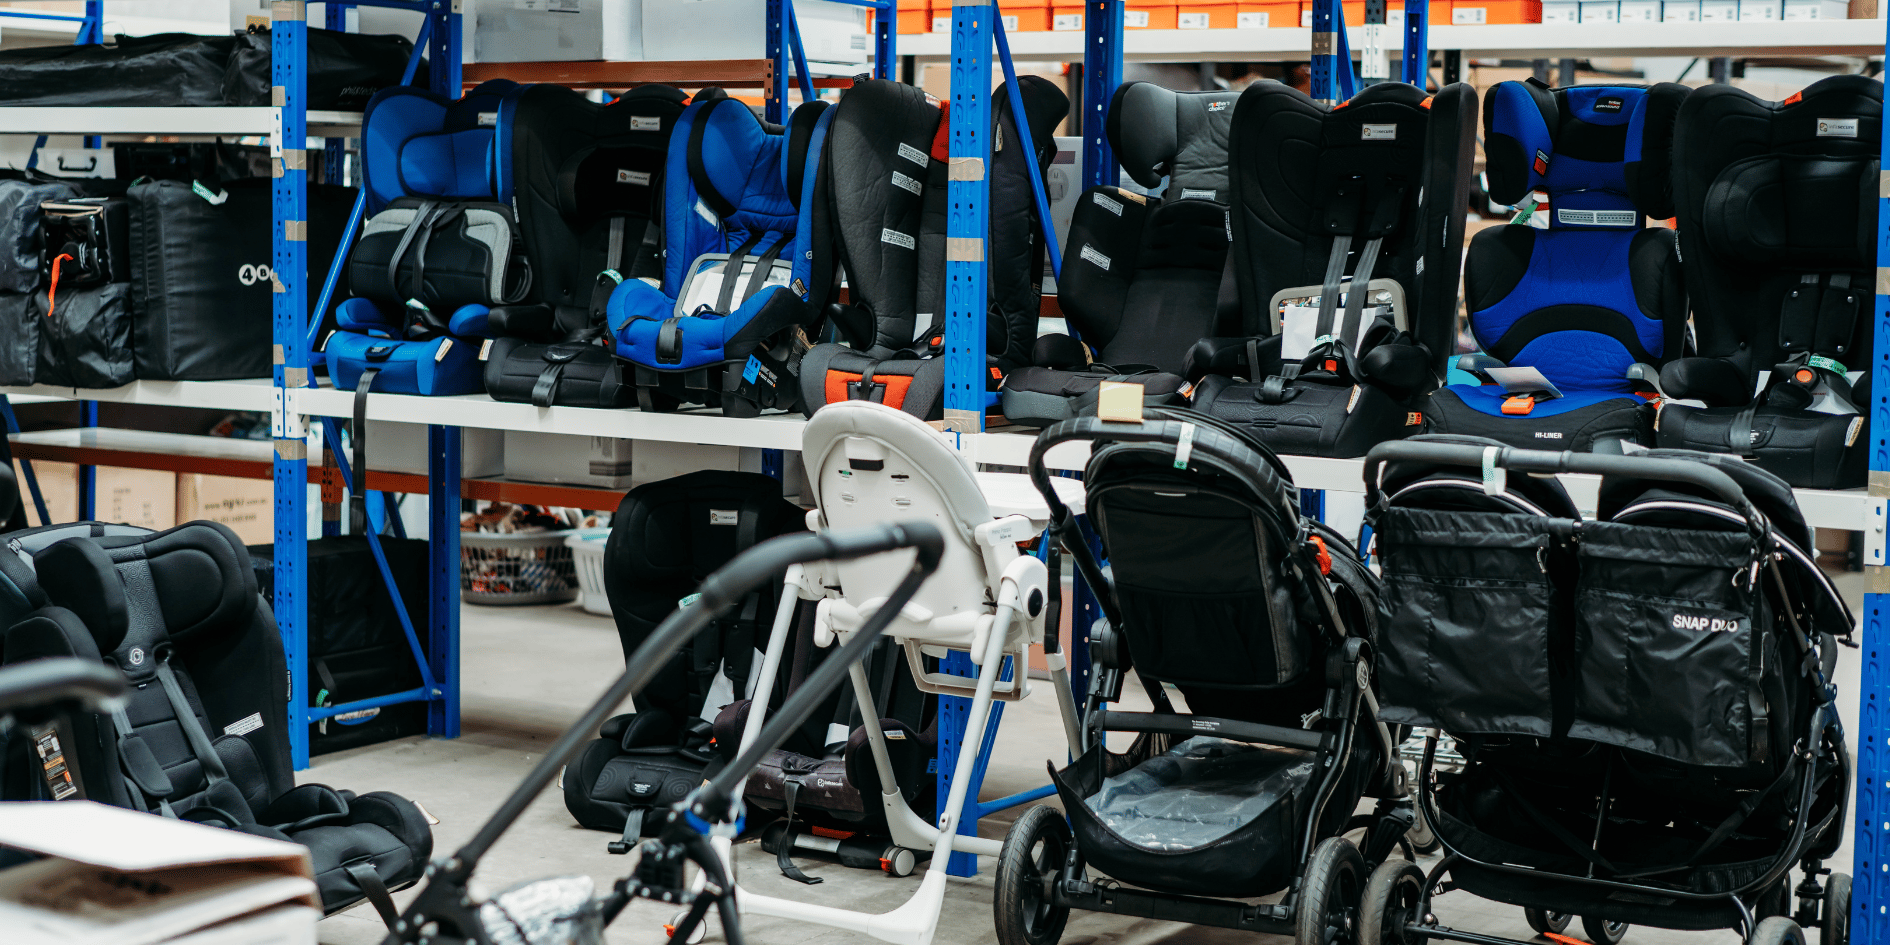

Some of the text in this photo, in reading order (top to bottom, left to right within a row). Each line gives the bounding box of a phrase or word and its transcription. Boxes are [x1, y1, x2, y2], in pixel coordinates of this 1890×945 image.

[1534, 431, 1564, 439] HI-LINER
[1672, 614, 1739, 633] SNAP DUO
